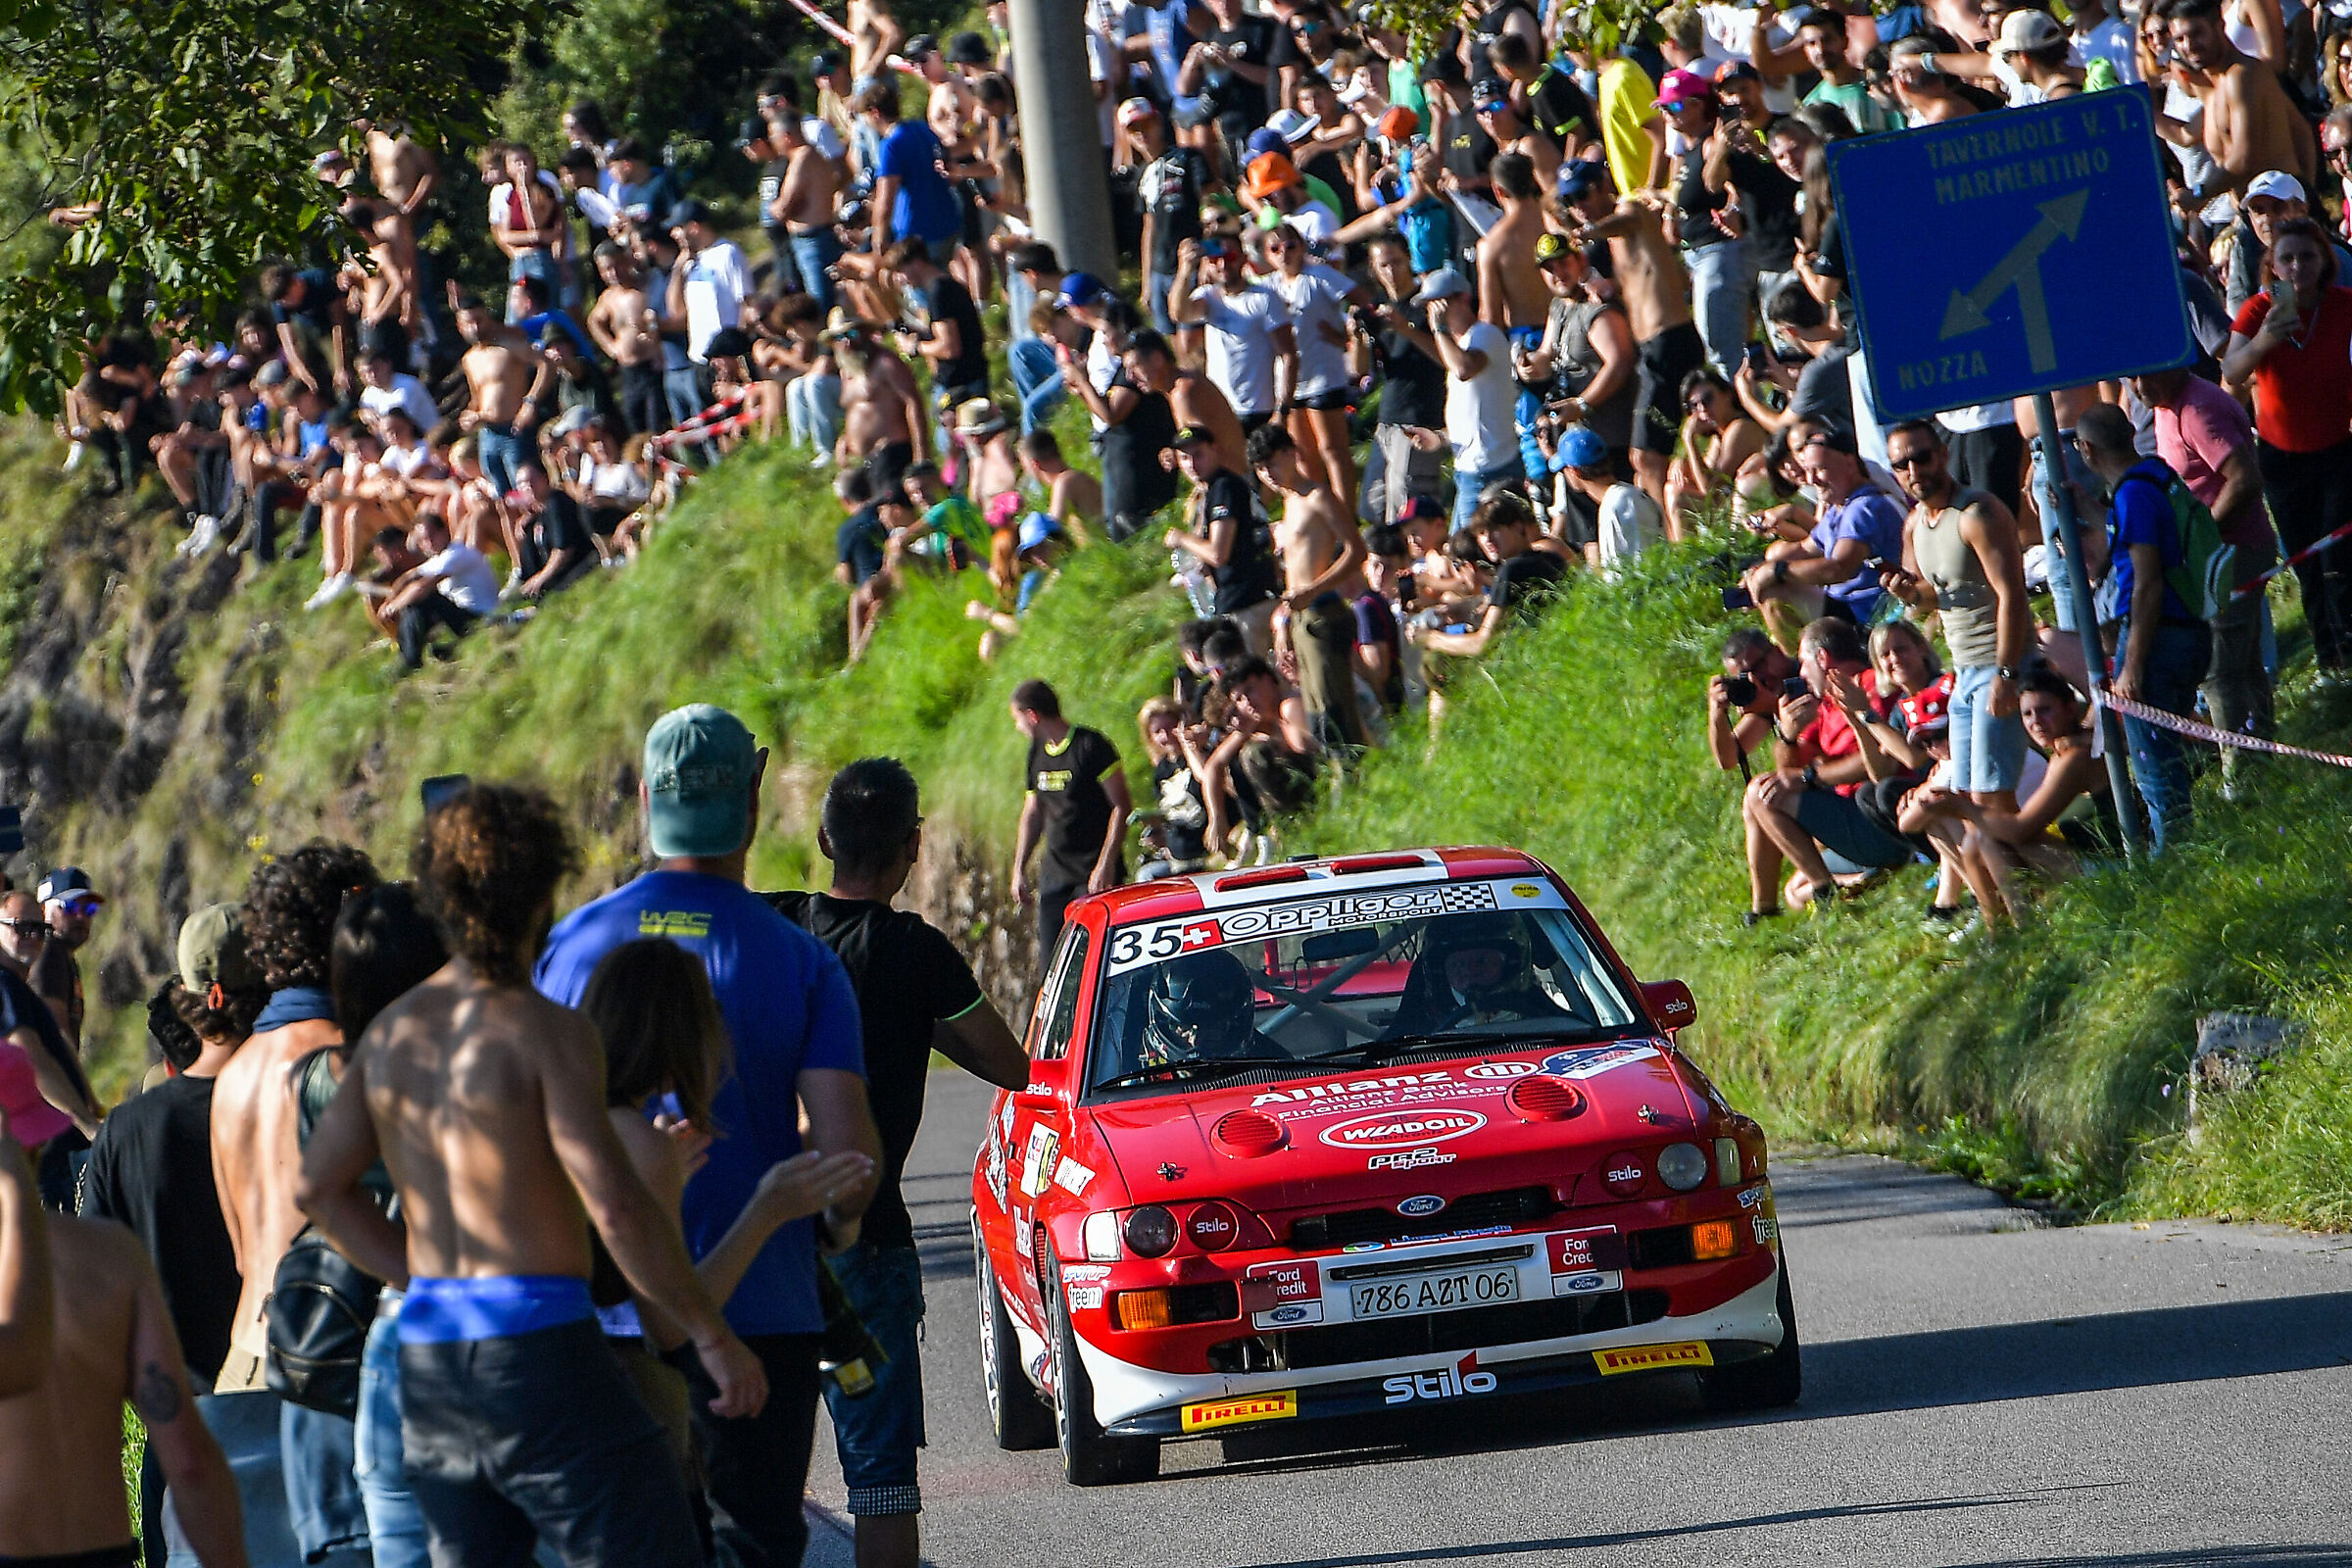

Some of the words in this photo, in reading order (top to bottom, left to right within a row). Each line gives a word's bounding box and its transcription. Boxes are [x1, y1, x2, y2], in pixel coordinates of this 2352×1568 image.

[1926, 119, 2070, 170] TAVERNOLE
[2082, 112, 2108, 138] V.
[2118, 105, 2138, 130] T.
[1935, 148, 2110, 204] MARMENTINO
[1898, 351, 1988, 391] NOZZA
[1330, 906, 1442, 925] MOTORSPORT
[1109, 924, 1183, 964] 35
[1250, 1071, 1452, 1107] Allianz
[1277, 1100, 1394, 1120] Financial
[1400, 1085, 1508, 1102] Advisors
[1309, 1090, 1396, 1106] Allianz
[1405, 1081, 1469, 1095] Bank
[1408, 1199, 1436, 1213] Ford
[1564, 1238, 1590, 1252] For
[1276, 1281, 1307, 1297] redit
[1359, 1285, 1411, 1314] 786
[1416, 1275, 1470, 1307] AZT
[1475, 1273, 1511, 1298] 06
[1604, 1344, 1702, 1368] PIRELLI
[1192, 1396, 1287, 1424] PIRELLI
